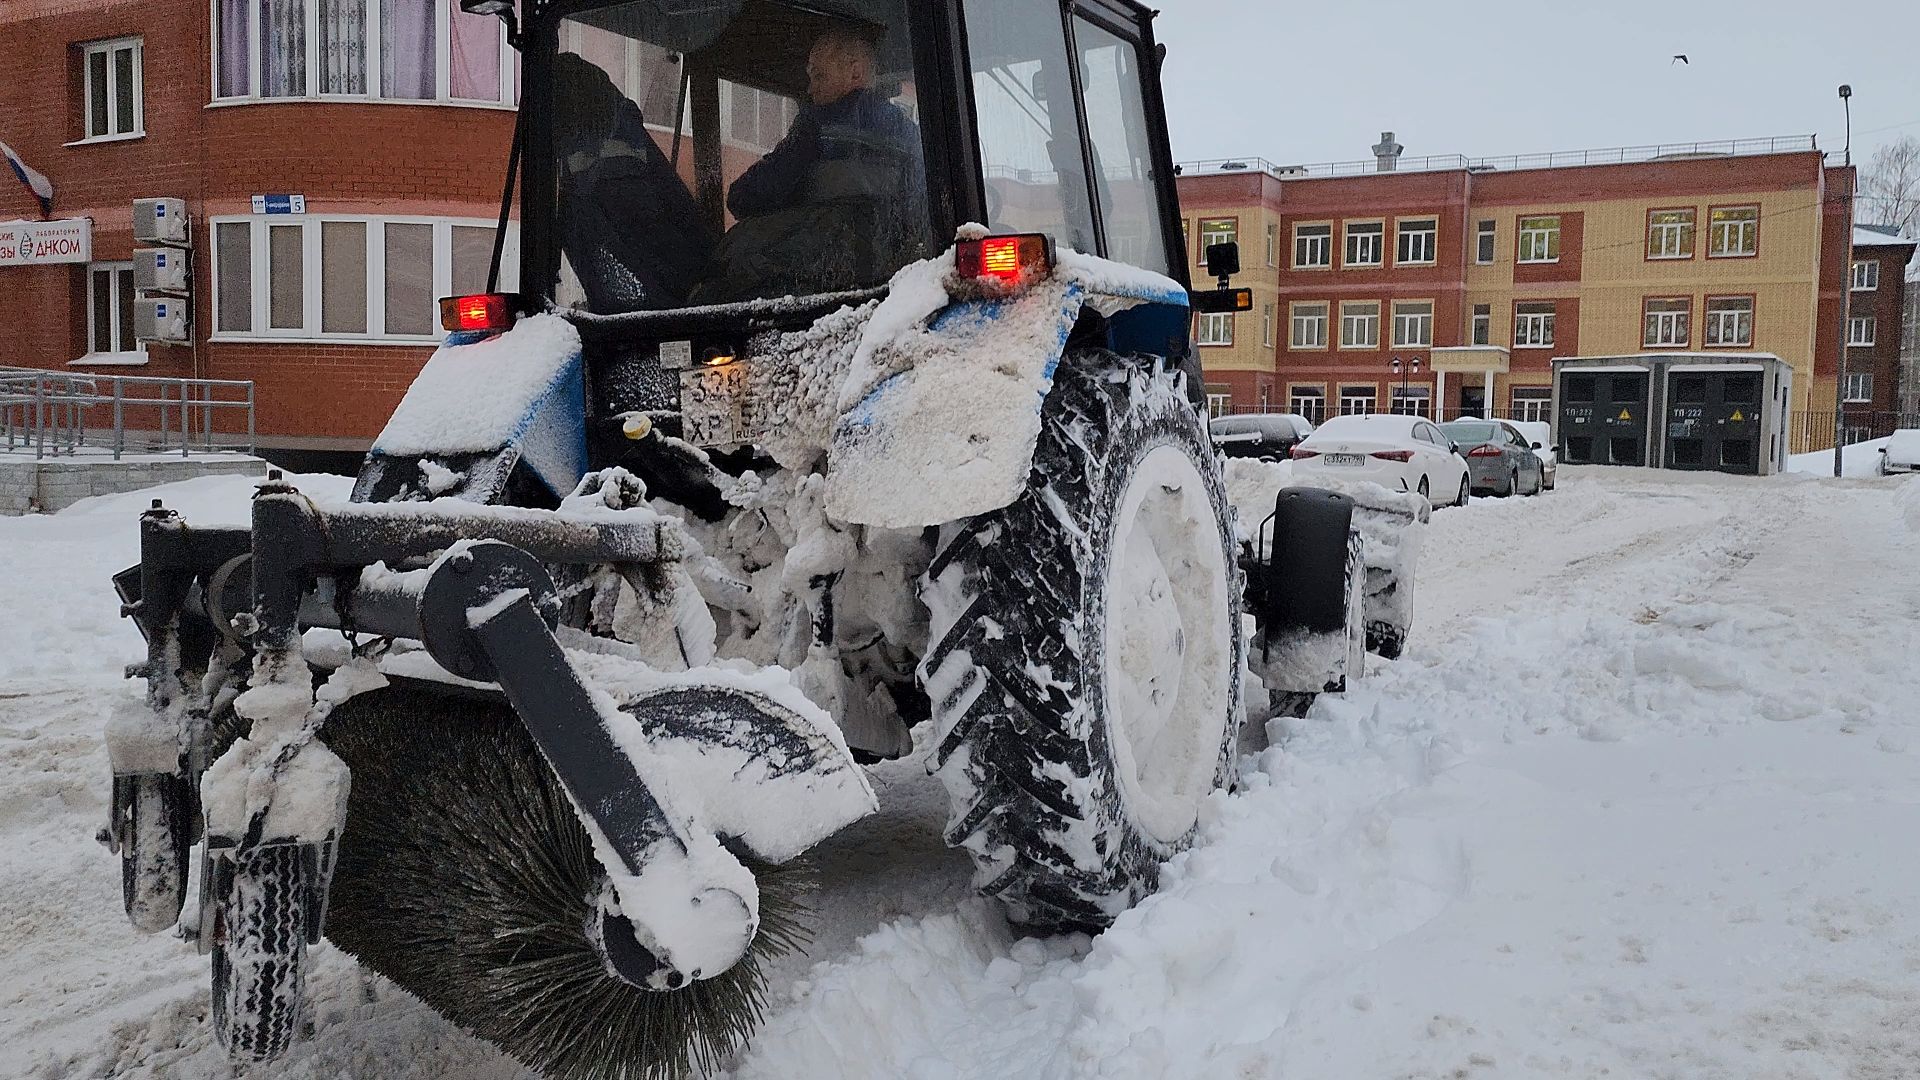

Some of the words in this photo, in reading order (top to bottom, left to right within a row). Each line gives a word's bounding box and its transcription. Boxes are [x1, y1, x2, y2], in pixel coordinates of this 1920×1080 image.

[295, 201, 301, 211] 5
[35, 238, 81, 258] ДНКОМ
[735, 429, 757, 439] RUS
